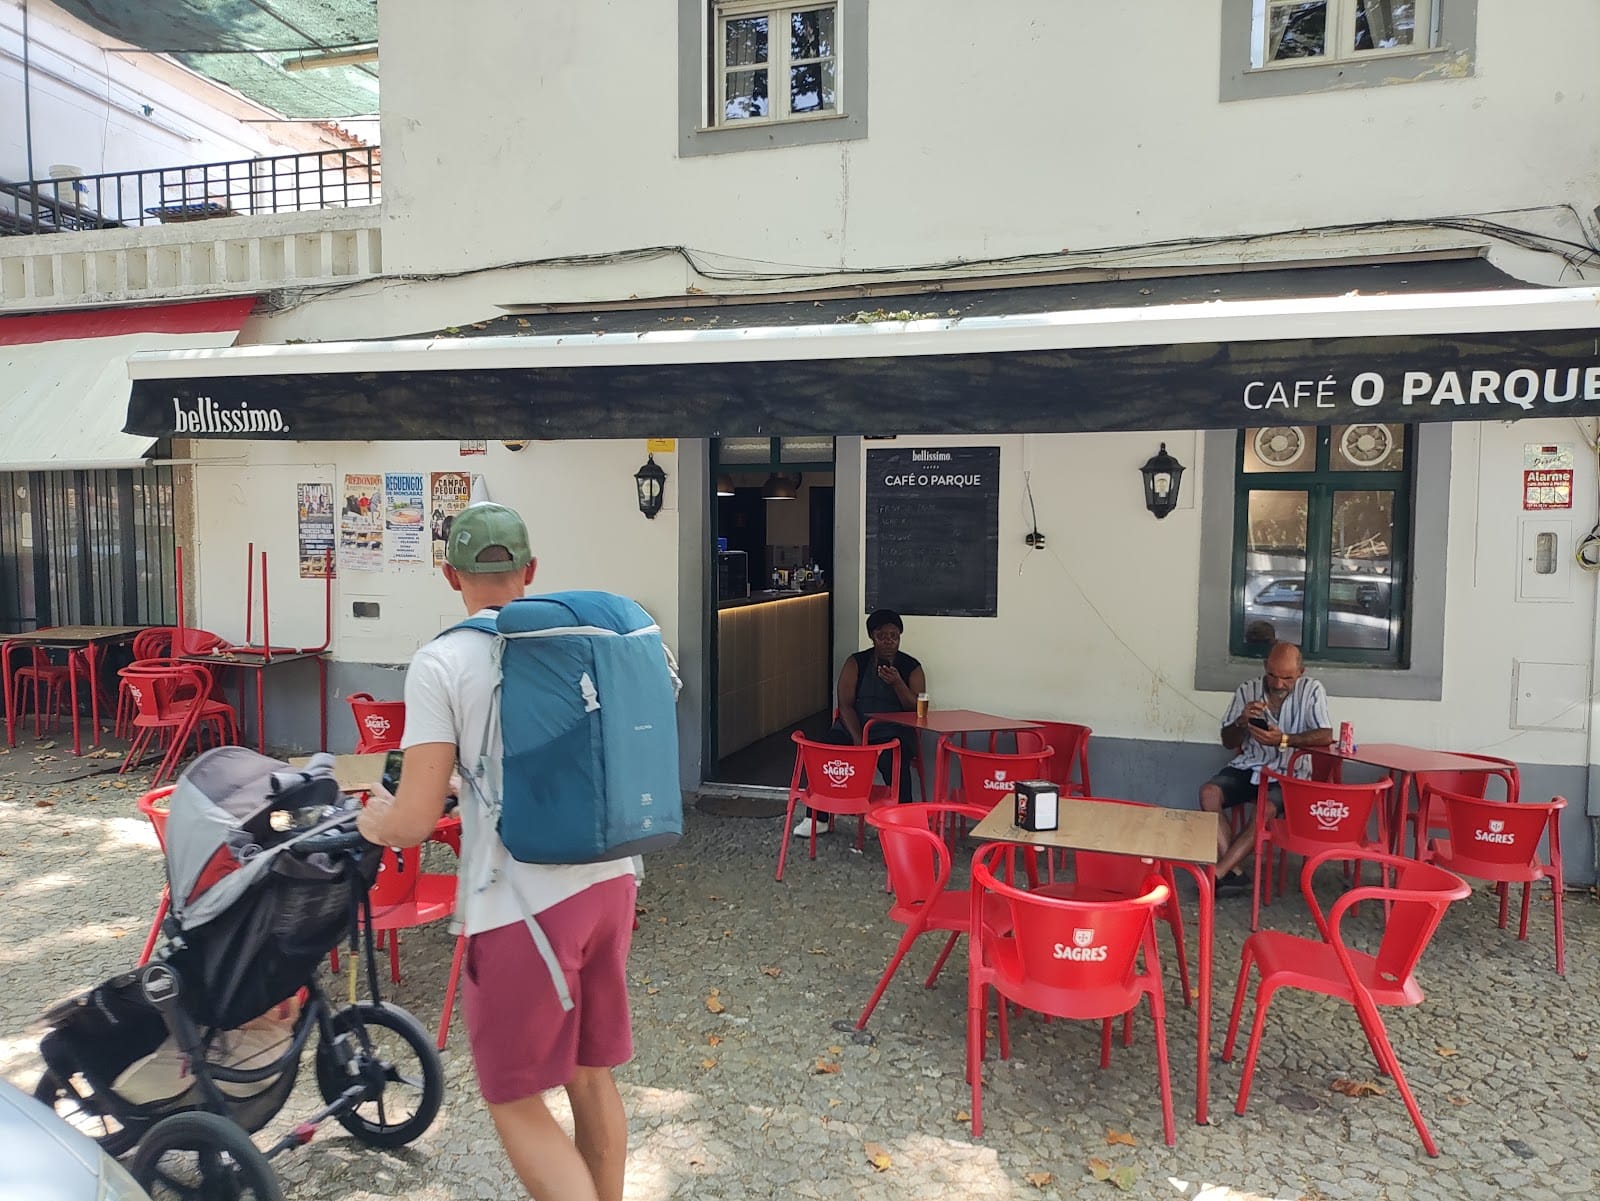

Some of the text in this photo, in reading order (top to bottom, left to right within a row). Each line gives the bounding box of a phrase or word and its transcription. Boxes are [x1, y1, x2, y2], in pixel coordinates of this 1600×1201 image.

[1243, 367, 1600, 411] CAFÉ O PARQUE
[173, 397, 290, 433] bellissimo.
[385, 476, 424, 491] REGUENGOS
[884, 472, 981, 487] CAFÉ O PARQUE
[1527, 471, 1571, 482] Alarme
[822, 763, 856, 777] SAGRES
[983, 779, 1016, 791] SAGRES
[1309, 804, 1350, 818] SAGRES
[1474, 829, 1515, 845] SAGRES
[1053, 943, 1108, 961] SAGRES
